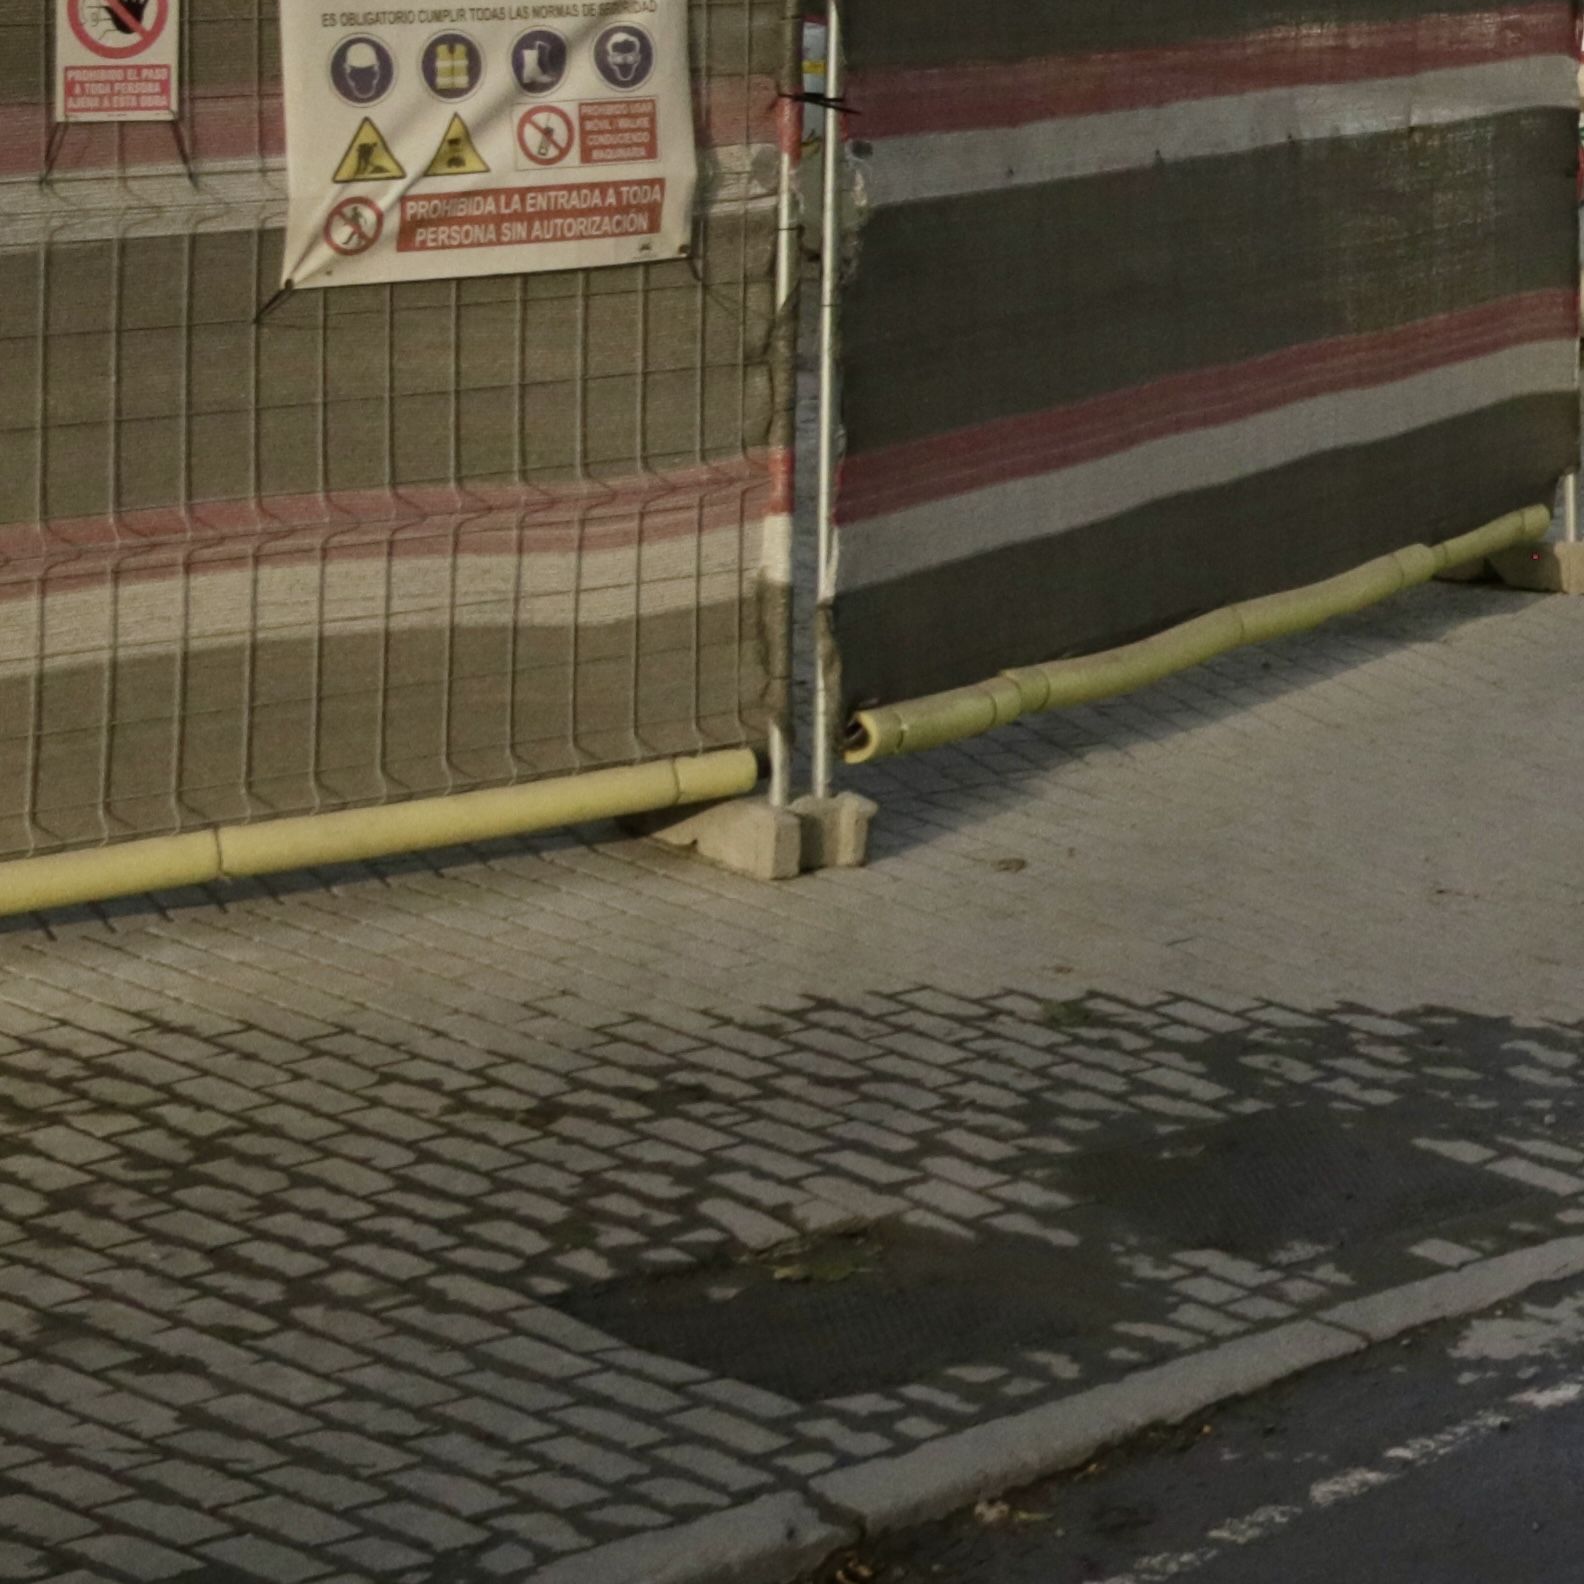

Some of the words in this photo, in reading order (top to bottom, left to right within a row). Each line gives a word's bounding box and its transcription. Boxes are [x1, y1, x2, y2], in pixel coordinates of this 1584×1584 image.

[322, 13, 338, 28] ES
[340, 9, 416, 27] OBLIGATORIO
[417, 8, 466, 24] CUMPLIR
[468, 6, 506, 22] TODAS
[509, 5, 529, 20] LAS
[531, 4, 579, 19] NORMAS
[582, 3, 598, 17] DE
[406, 195, 496, 222] PROHIBIDA
[500, 196, 522, 215] LA
[525, 188, 602, 213] ENTRADA
[604, 188, 617, 207] A
[620, 184, 662, 206] TODA
[414, 223, 497, 248] PERSONA
[500, 220, 527, 243] SIN
[530, 209, 649, 241] AUTORIZACIÓN
